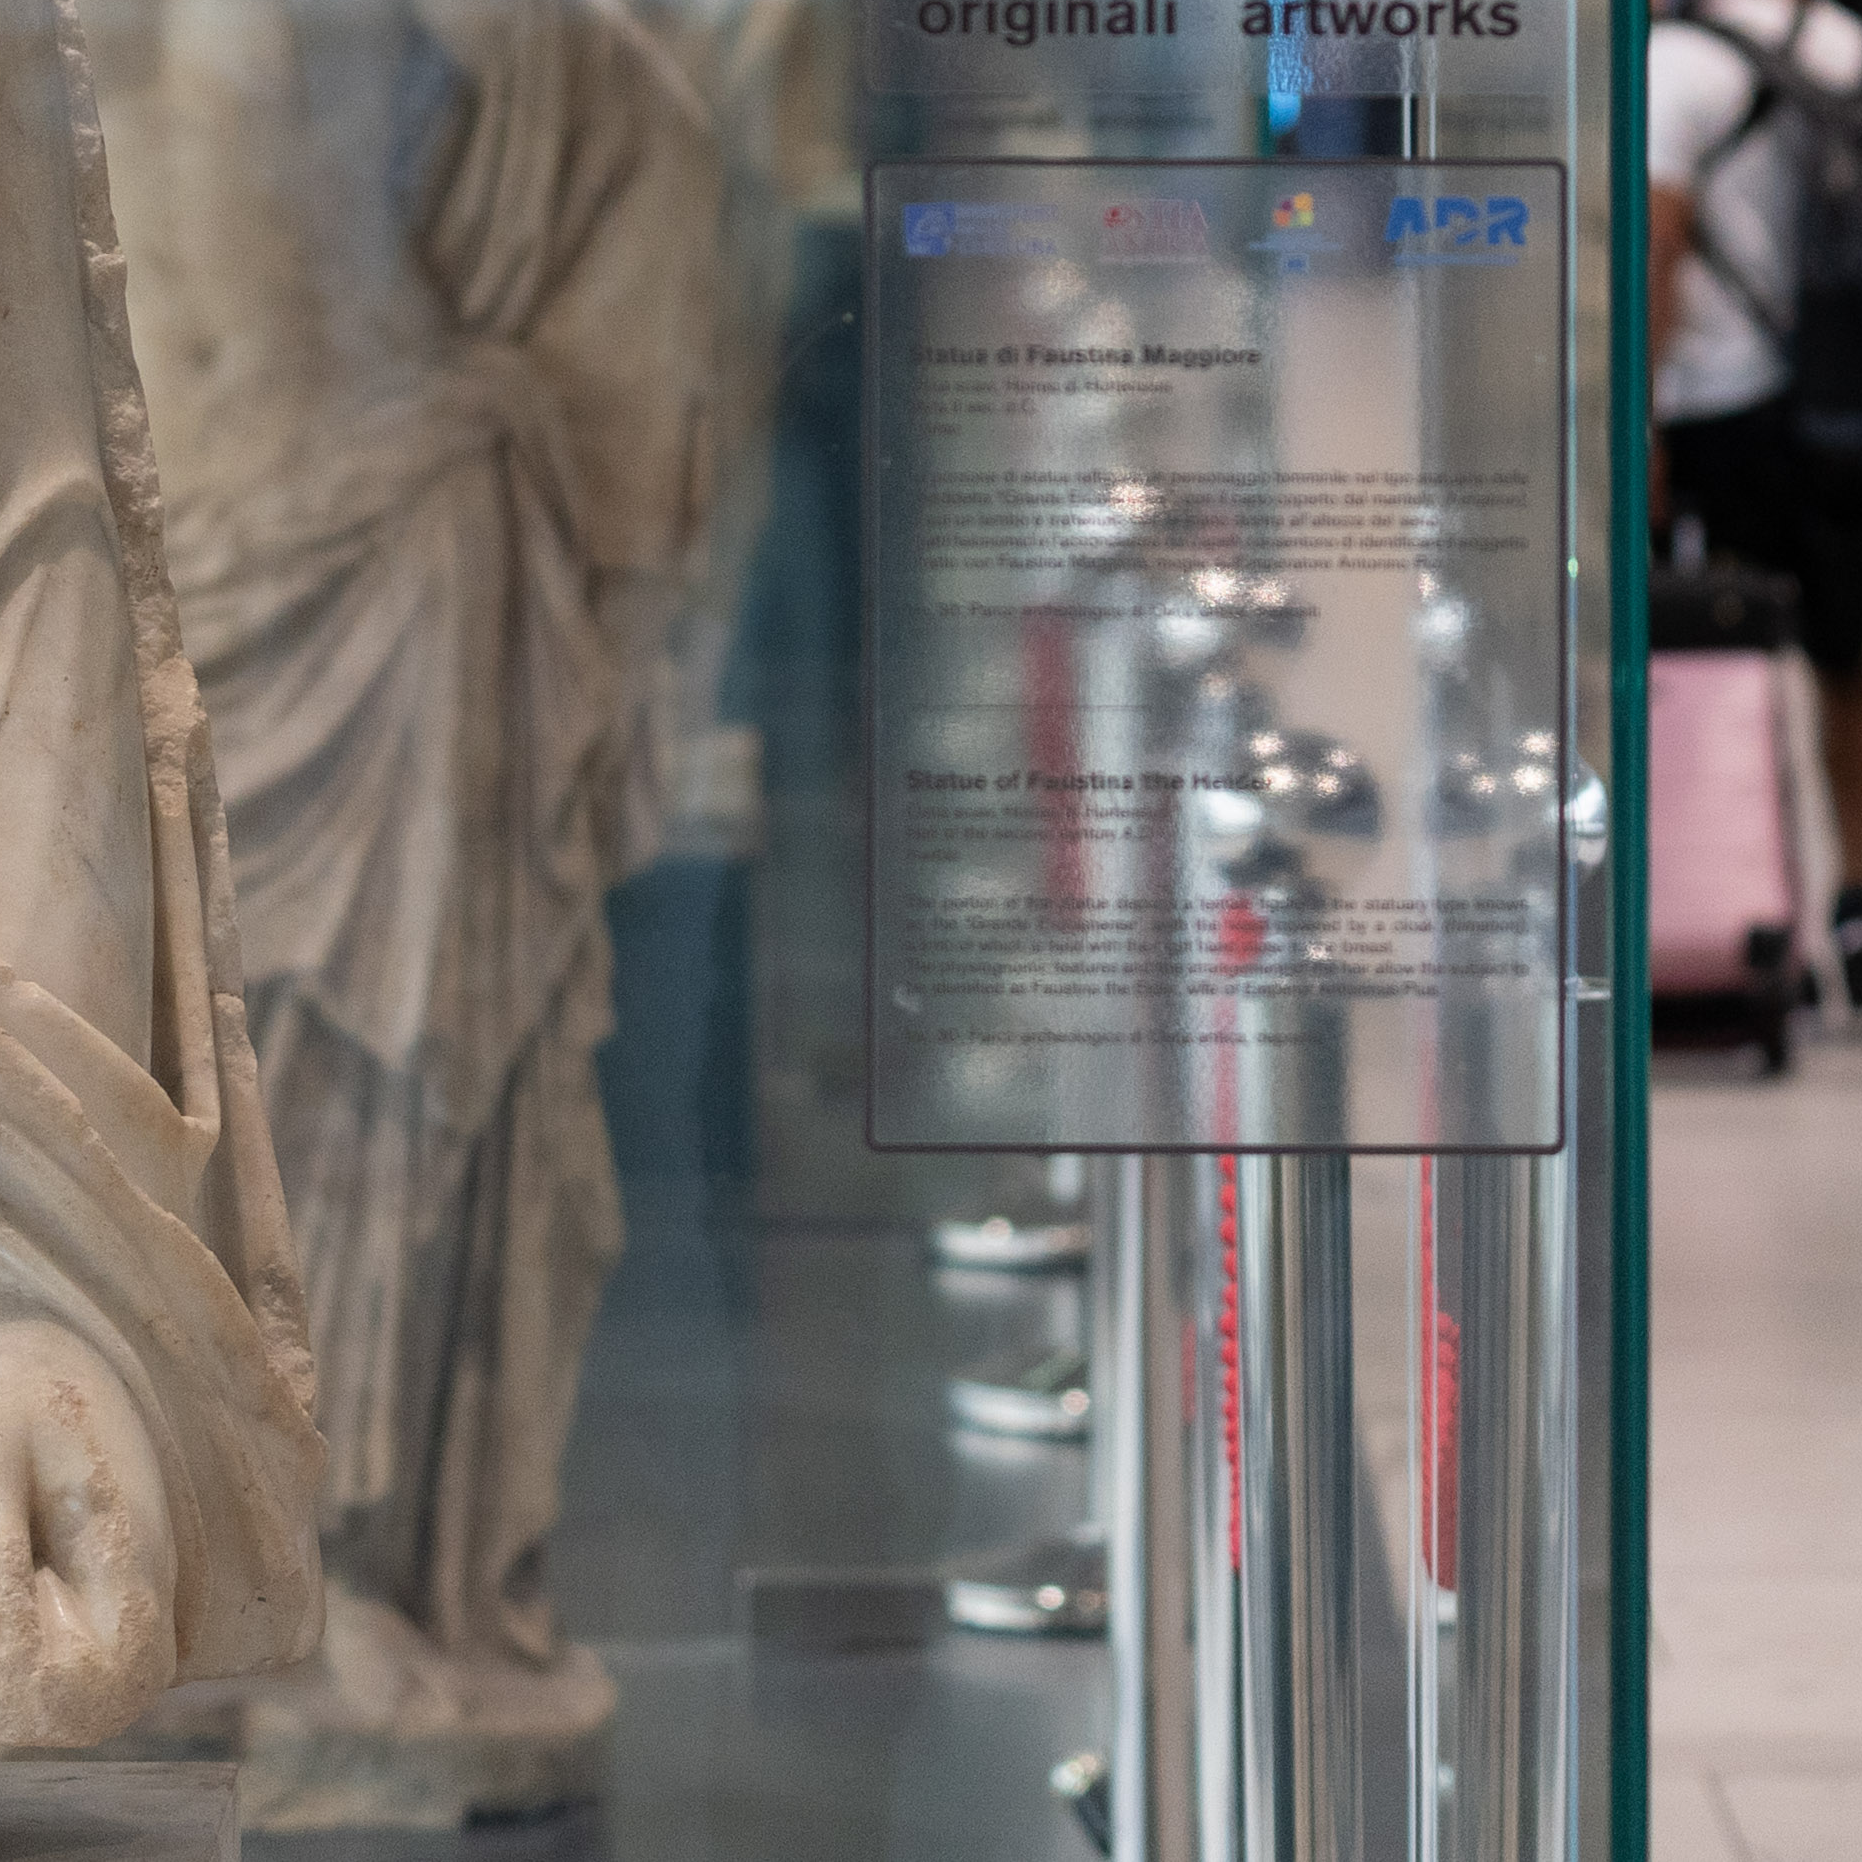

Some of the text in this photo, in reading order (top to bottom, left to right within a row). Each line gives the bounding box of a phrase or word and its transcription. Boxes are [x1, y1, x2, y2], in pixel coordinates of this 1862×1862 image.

[1384, 195, 1530, 247] ADR
[909, 344, 1261, 369] Statua di Faustina Maggiore
[905, 769, 988, 791] Statue
[994, 769, 1020, 791] of
[1026, 769, 1134, 791] Faustina
